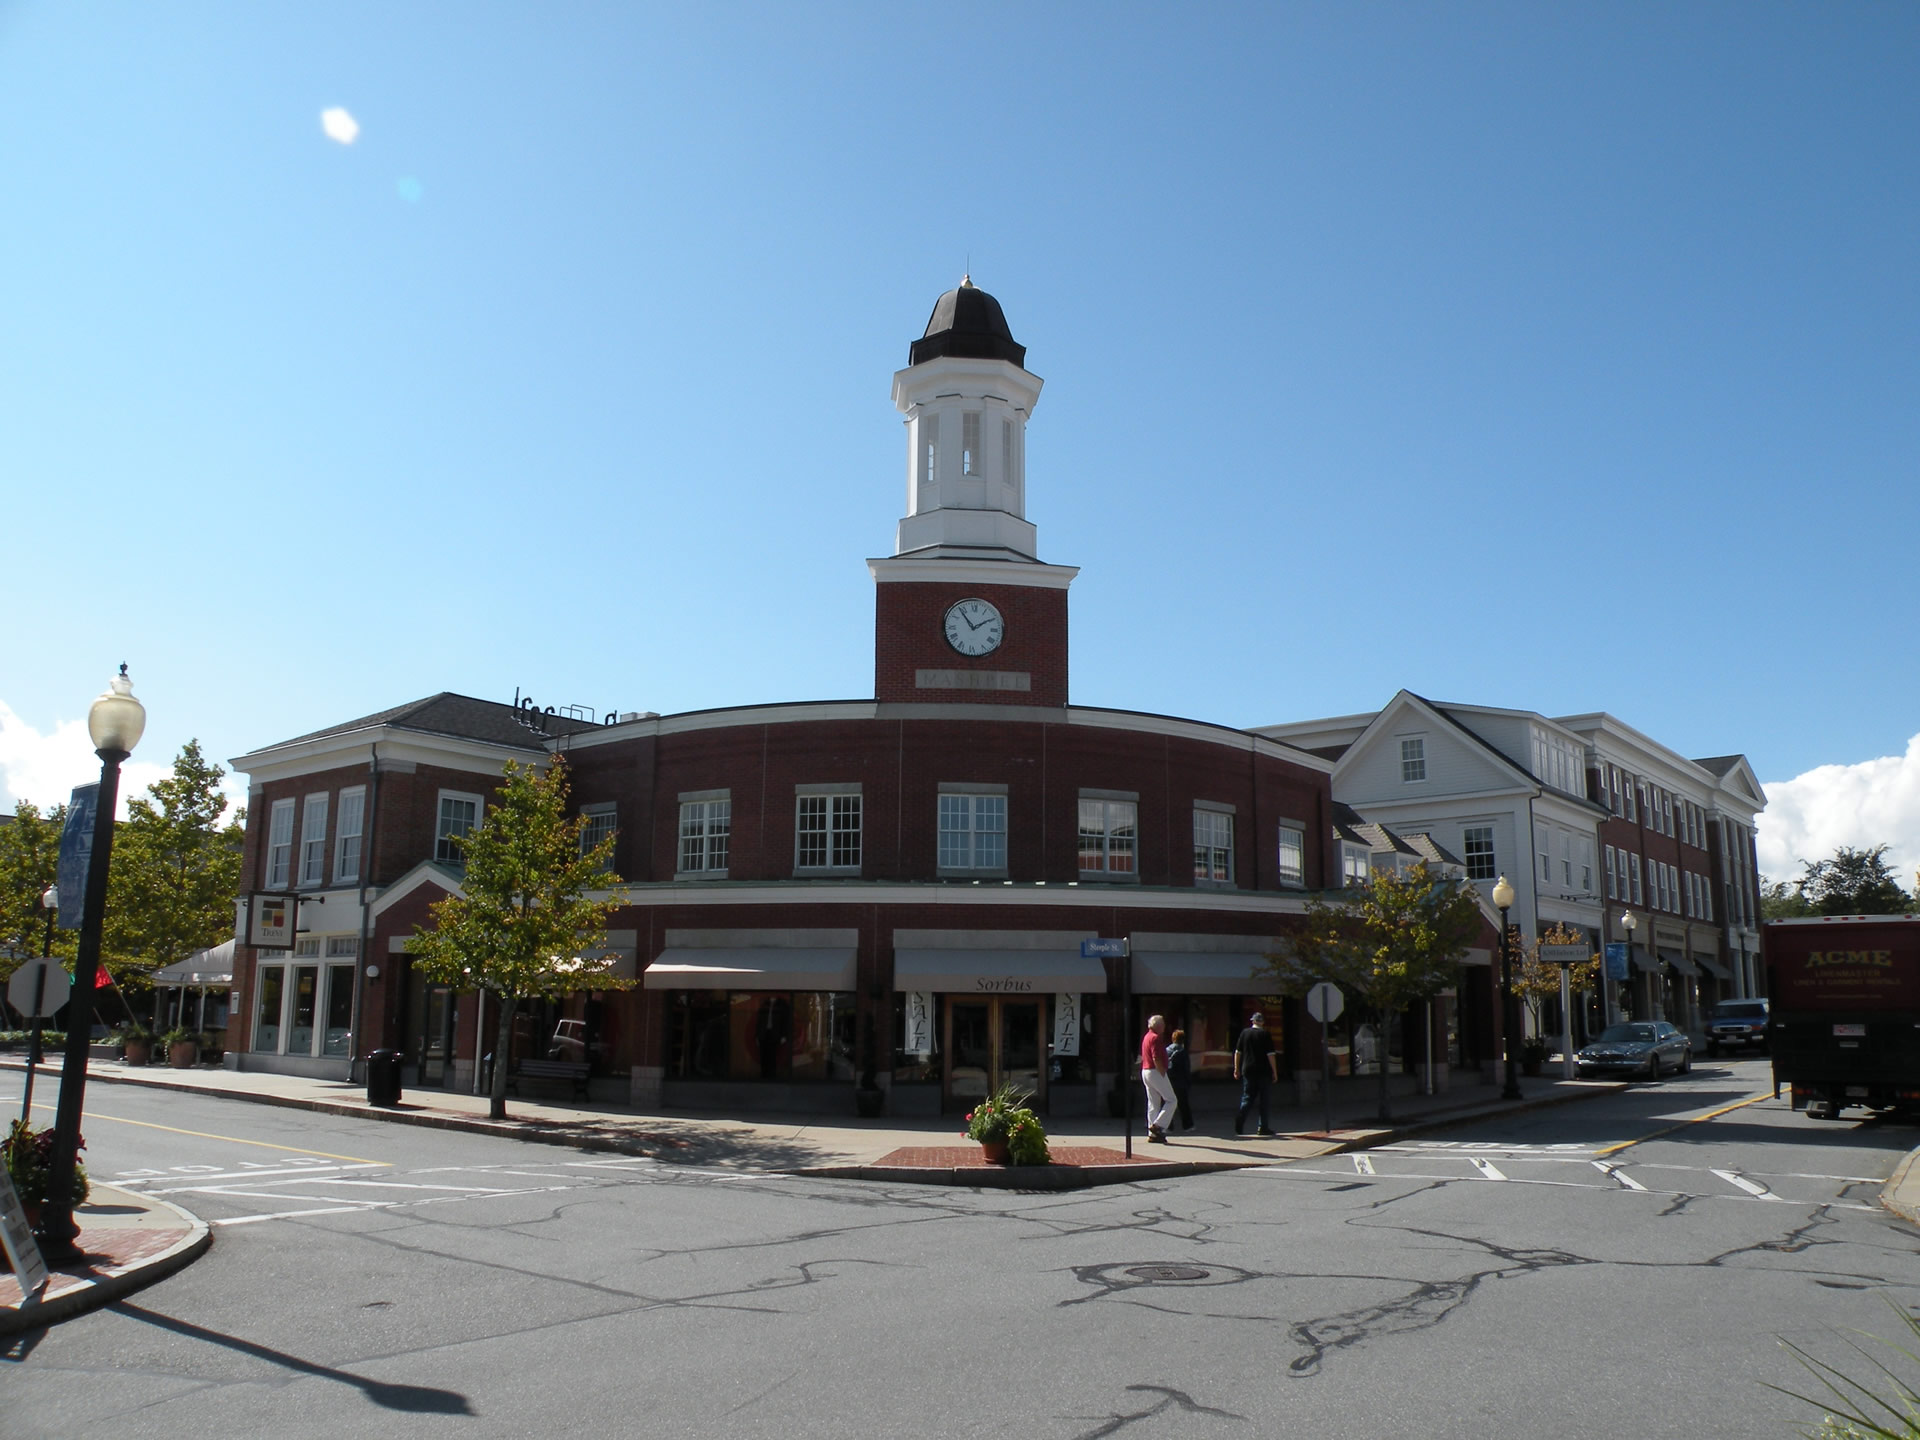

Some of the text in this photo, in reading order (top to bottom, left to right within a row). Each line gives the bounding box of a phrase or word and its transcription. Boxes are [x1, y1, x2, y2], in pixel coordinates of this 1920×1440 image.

[923, 673, 1025, 689] MASHPEE
[1804, 950, 1893, 968] ACME
[976, 976, 1032, 991] Sorbus
[1059, 992, 1076, 1053] SALE
[114, 1157, 332, 1176] STOP
